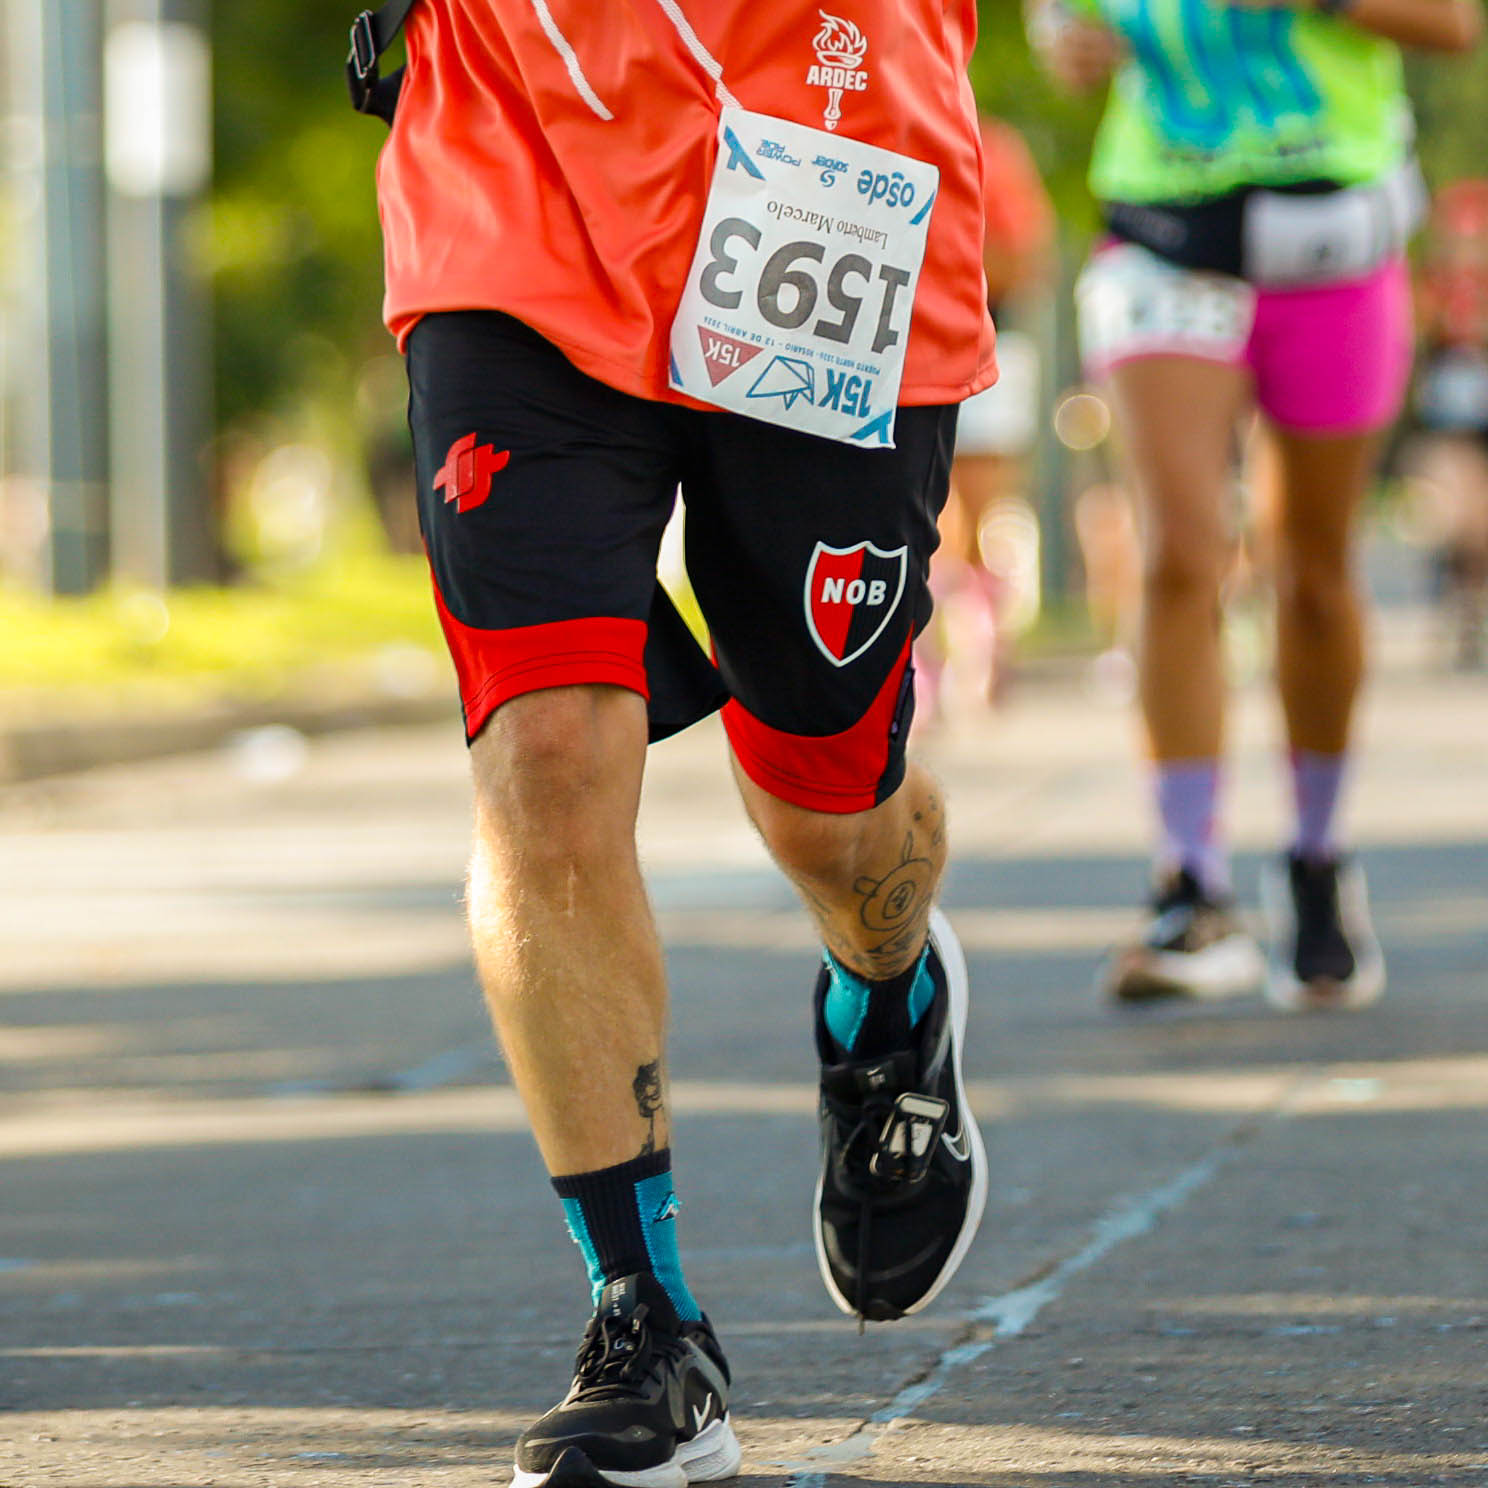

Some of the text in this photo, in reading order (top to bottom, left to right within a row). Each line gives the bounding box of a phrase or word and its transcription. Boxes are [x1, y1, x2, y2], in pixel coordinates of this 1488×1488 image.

[805, 64, 868, 91] ARDEC
[857, 169, 915, 208] osde
[766, 200, 888, 250] Lamberto Marcelo
[698, 216, 910, 355] 1593
[724, 323, 747, 338] ABRIL
[751, 332, 762, 342] DE
[704, 337, 742, 368] 15K
[784, 343, 815, 358] ROSARIO
[818, 368, 873, 418] 15K
[820, 575, 887, 605] NOB
